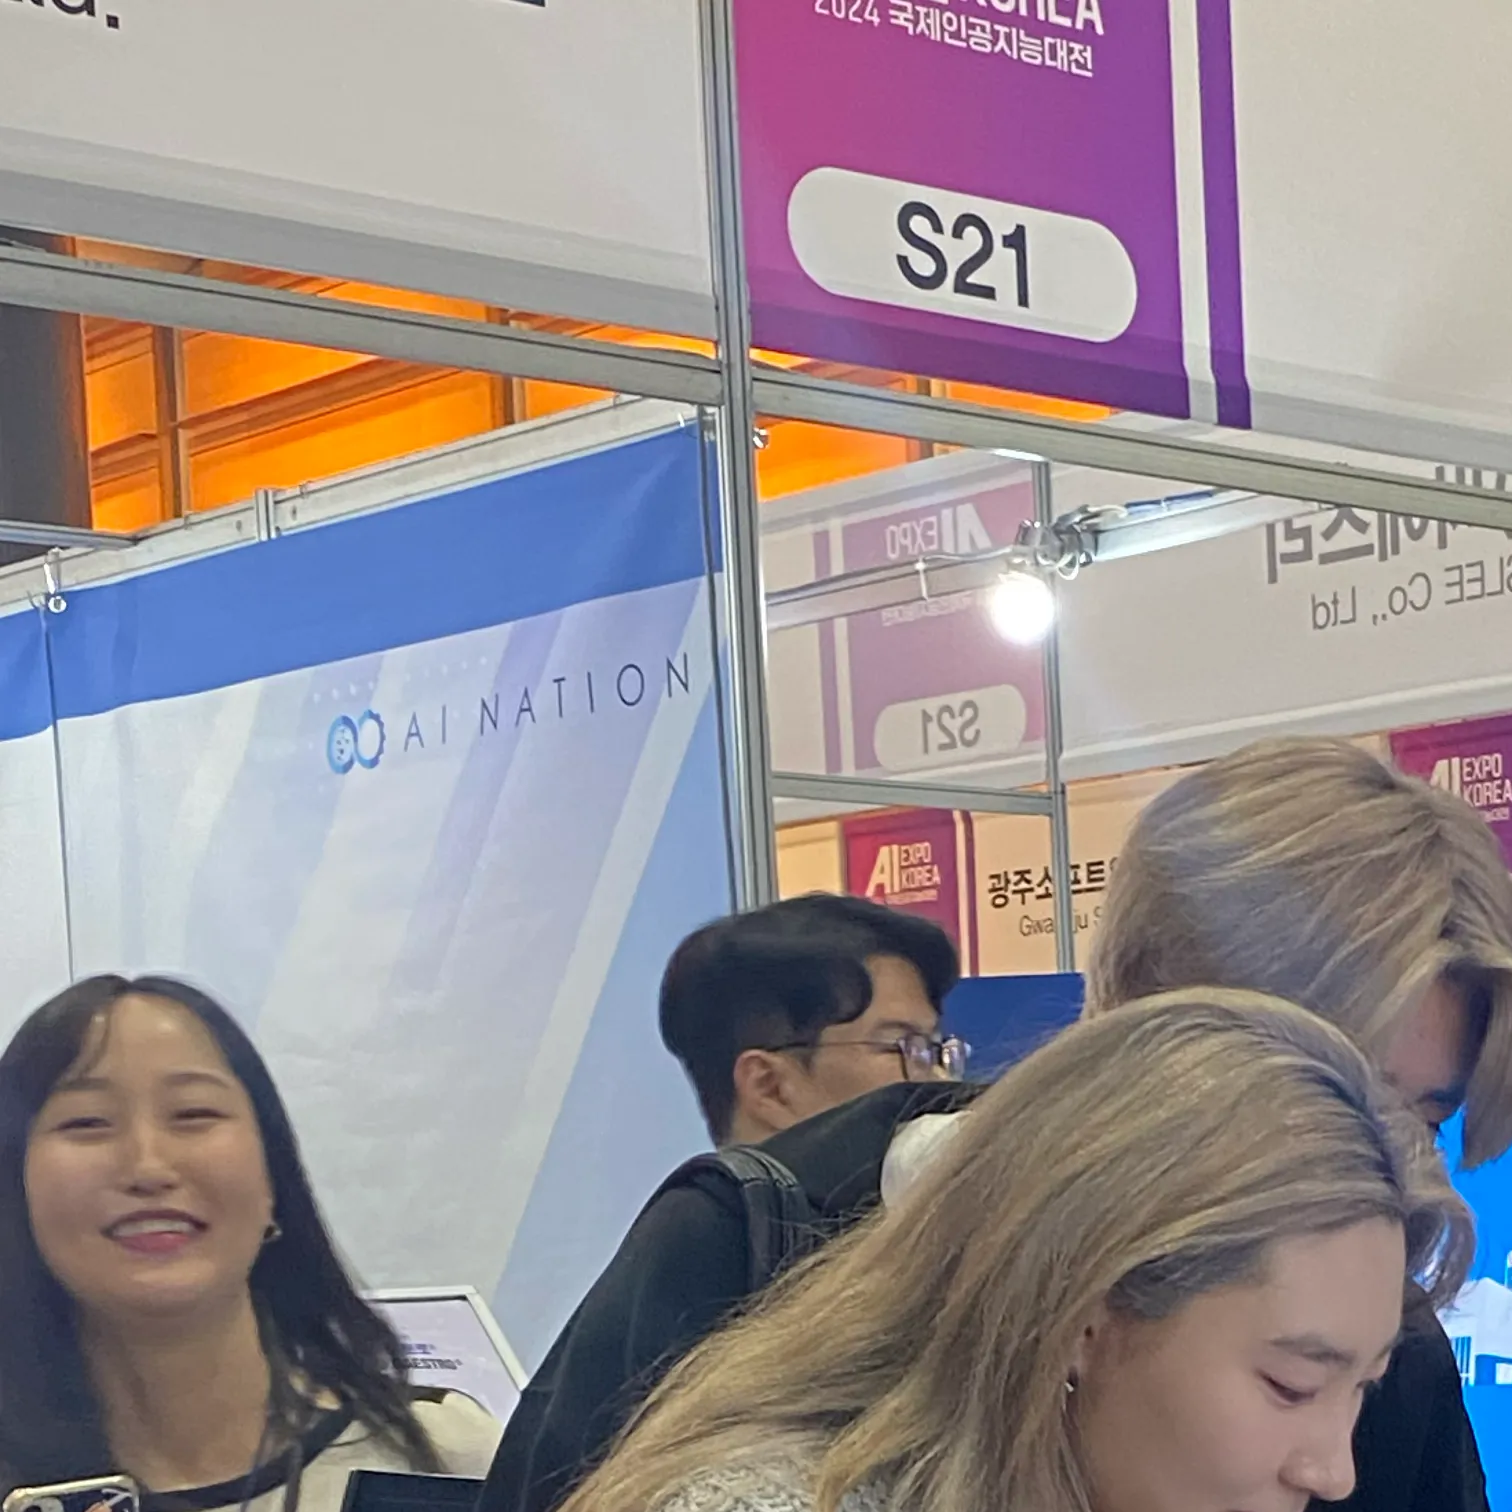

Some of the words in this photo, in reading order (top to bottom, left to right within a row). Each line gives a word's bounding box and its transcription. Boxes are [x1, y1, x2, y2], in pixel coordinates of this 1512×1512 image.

[889, 5, 1094, 78] 국제인공지능대전
[895, 201, 1030, 309] S21
[402, 705, 447, 753] AI
[479, 651, 693, 735] NATION
[1462, 752, 1503, 783] EXPO
[864, 843, 900, 898] AI
[900, 841, 932, 867] EXPO
[901, 864, 941, 889] KOREA
[987, 856, 1119, 909] 광주소프트
[1018, 912, 1089, 937] Gwaju
